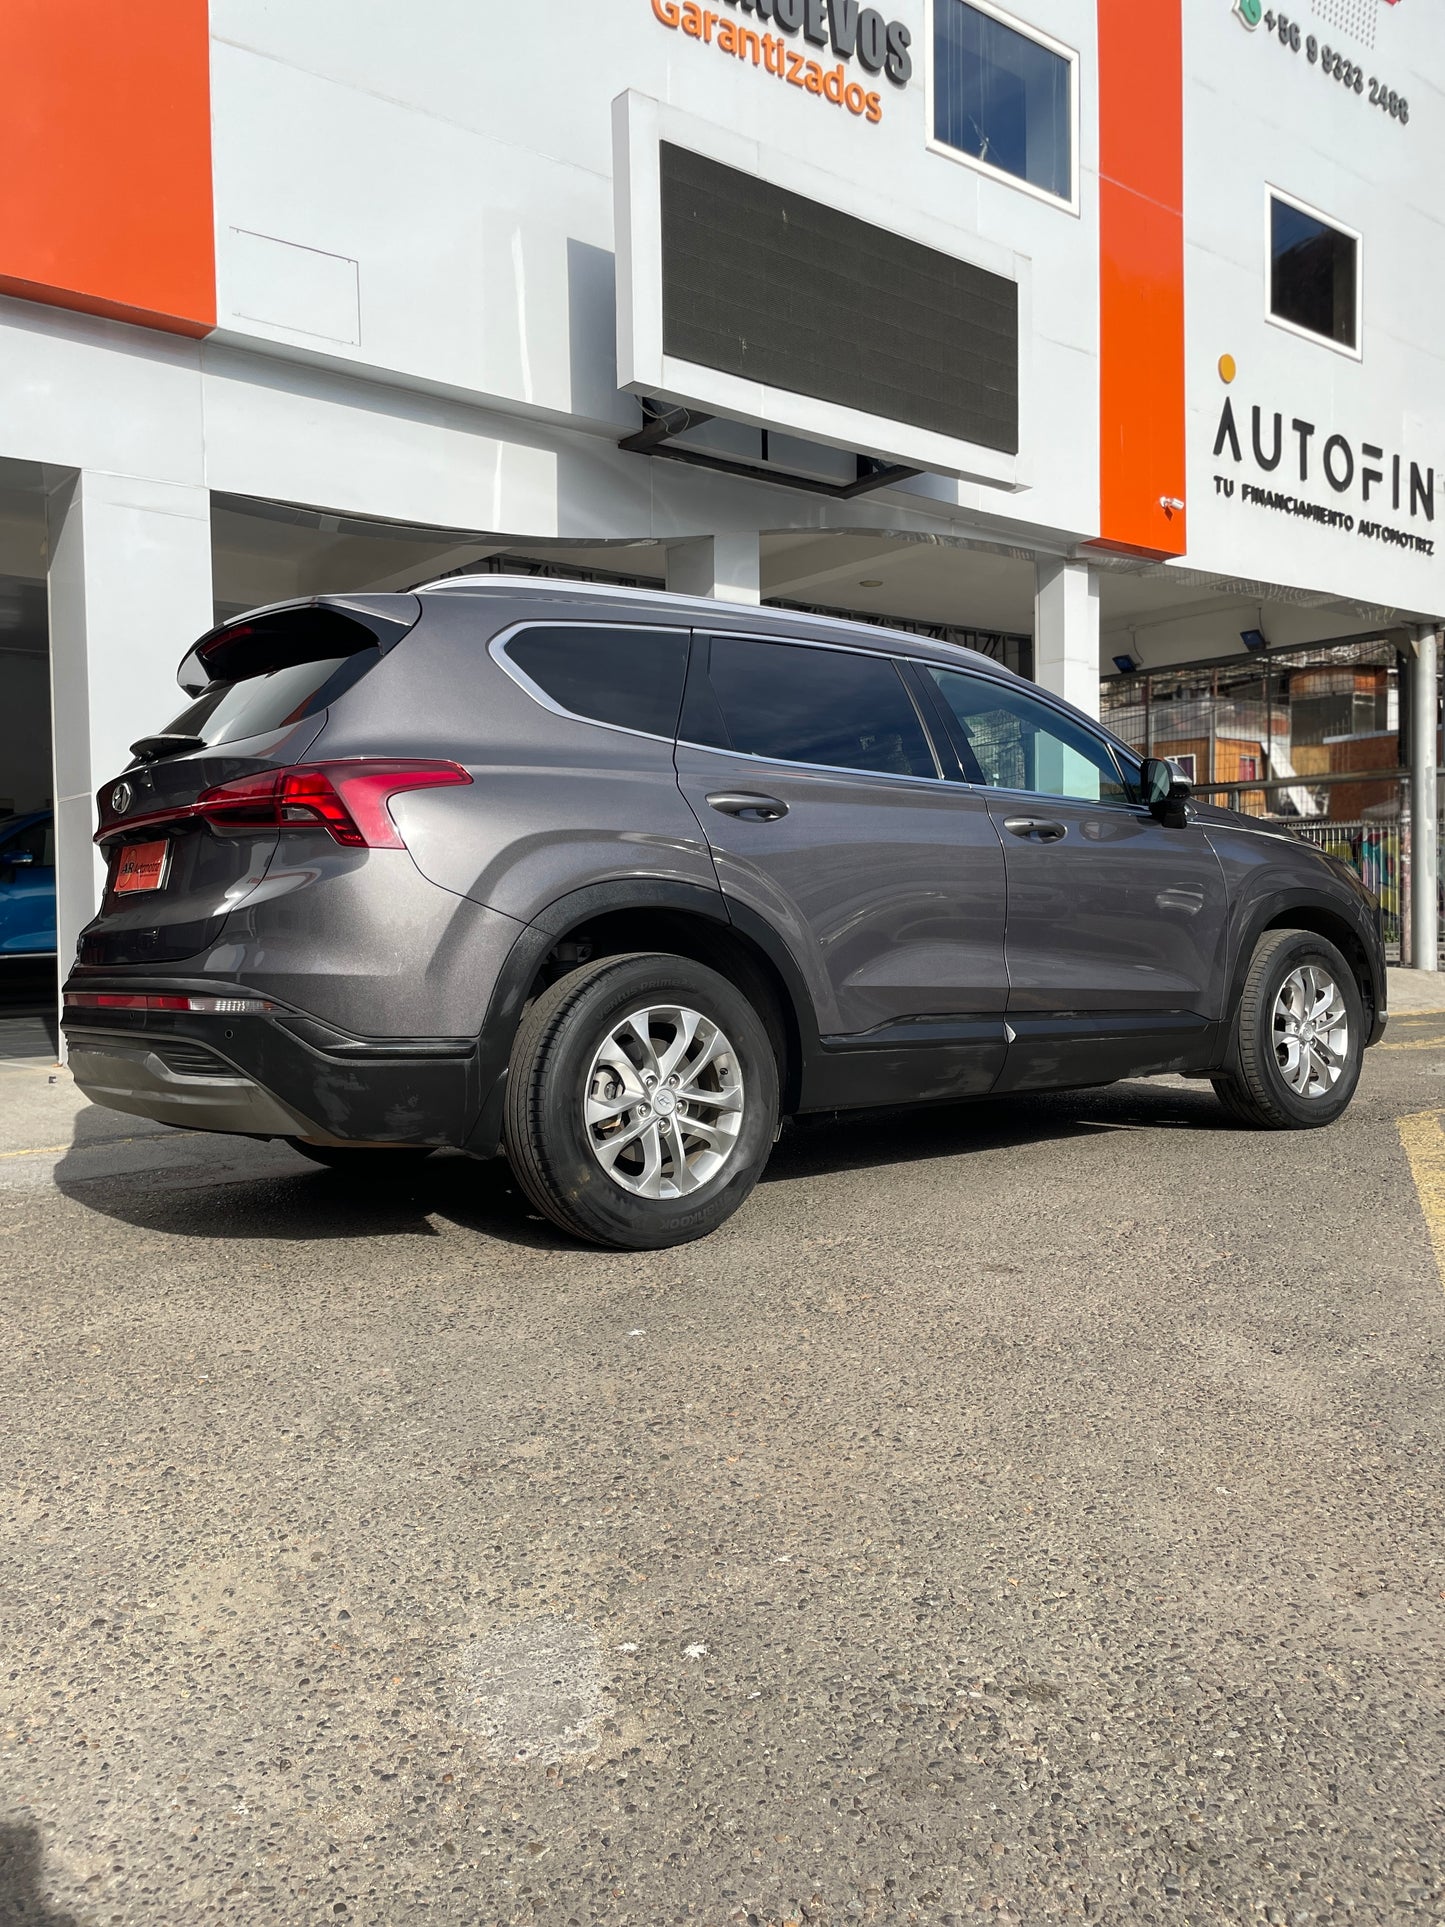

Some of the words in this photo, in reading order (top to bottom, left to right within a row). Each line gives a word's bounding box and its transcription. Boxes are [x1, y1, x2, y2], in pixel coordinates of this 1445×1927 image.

[651, 0, 883, 124] Garantizados
[1264, 9, 1301, 53] +56
[1306, 34, 1318, 64] 9
[1212, 394, 1435, 522] AUTOFIN
[1213, 475, 1235, 499] TU
[1241, 483, 1355, 533] FINANCIAMIENTO
[1357, 519, 1435, 557] AUTOMOTRIZ
